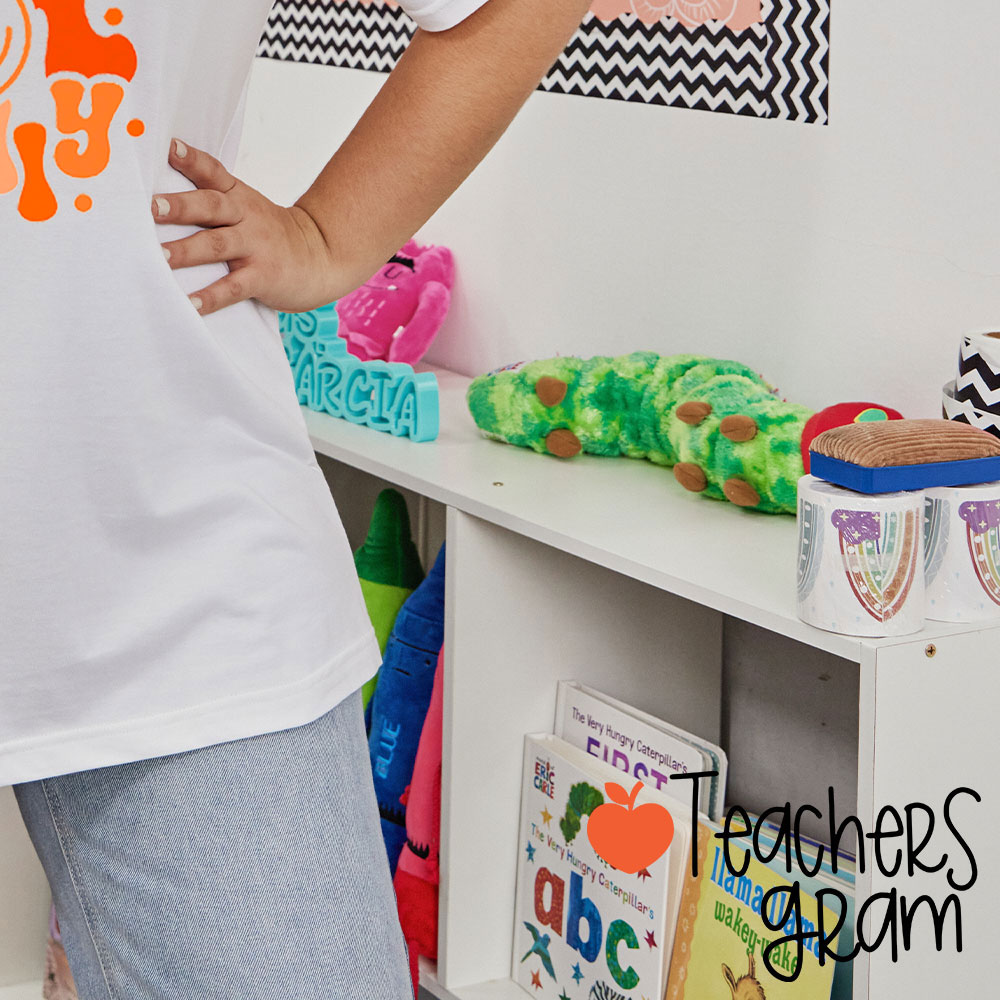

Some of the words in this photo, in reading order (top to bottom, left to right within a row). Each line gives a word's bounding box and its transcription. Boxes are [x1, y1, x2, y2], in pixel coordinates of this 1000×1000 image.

[294, 352, 418, 437] ARCIA
[375, 716, 401, 780] BLUE
[534, 761, 556, 786] ERIC
[572, 706, 586, 725] The
[587, 713, 604, 735] Very
[606, 725, 635, 751] Hungry
[636, 739, 688, 774] Caterpillar's
[533, 775, 555, 800] CARLE
[531, 822, 545, 842] The
[547, 834, 565, 861] Very
[566, 850, 597, 884] Hungry
[598, 873, 655, 920] Caterpillar's
[534, 866, 641, 991] abc
